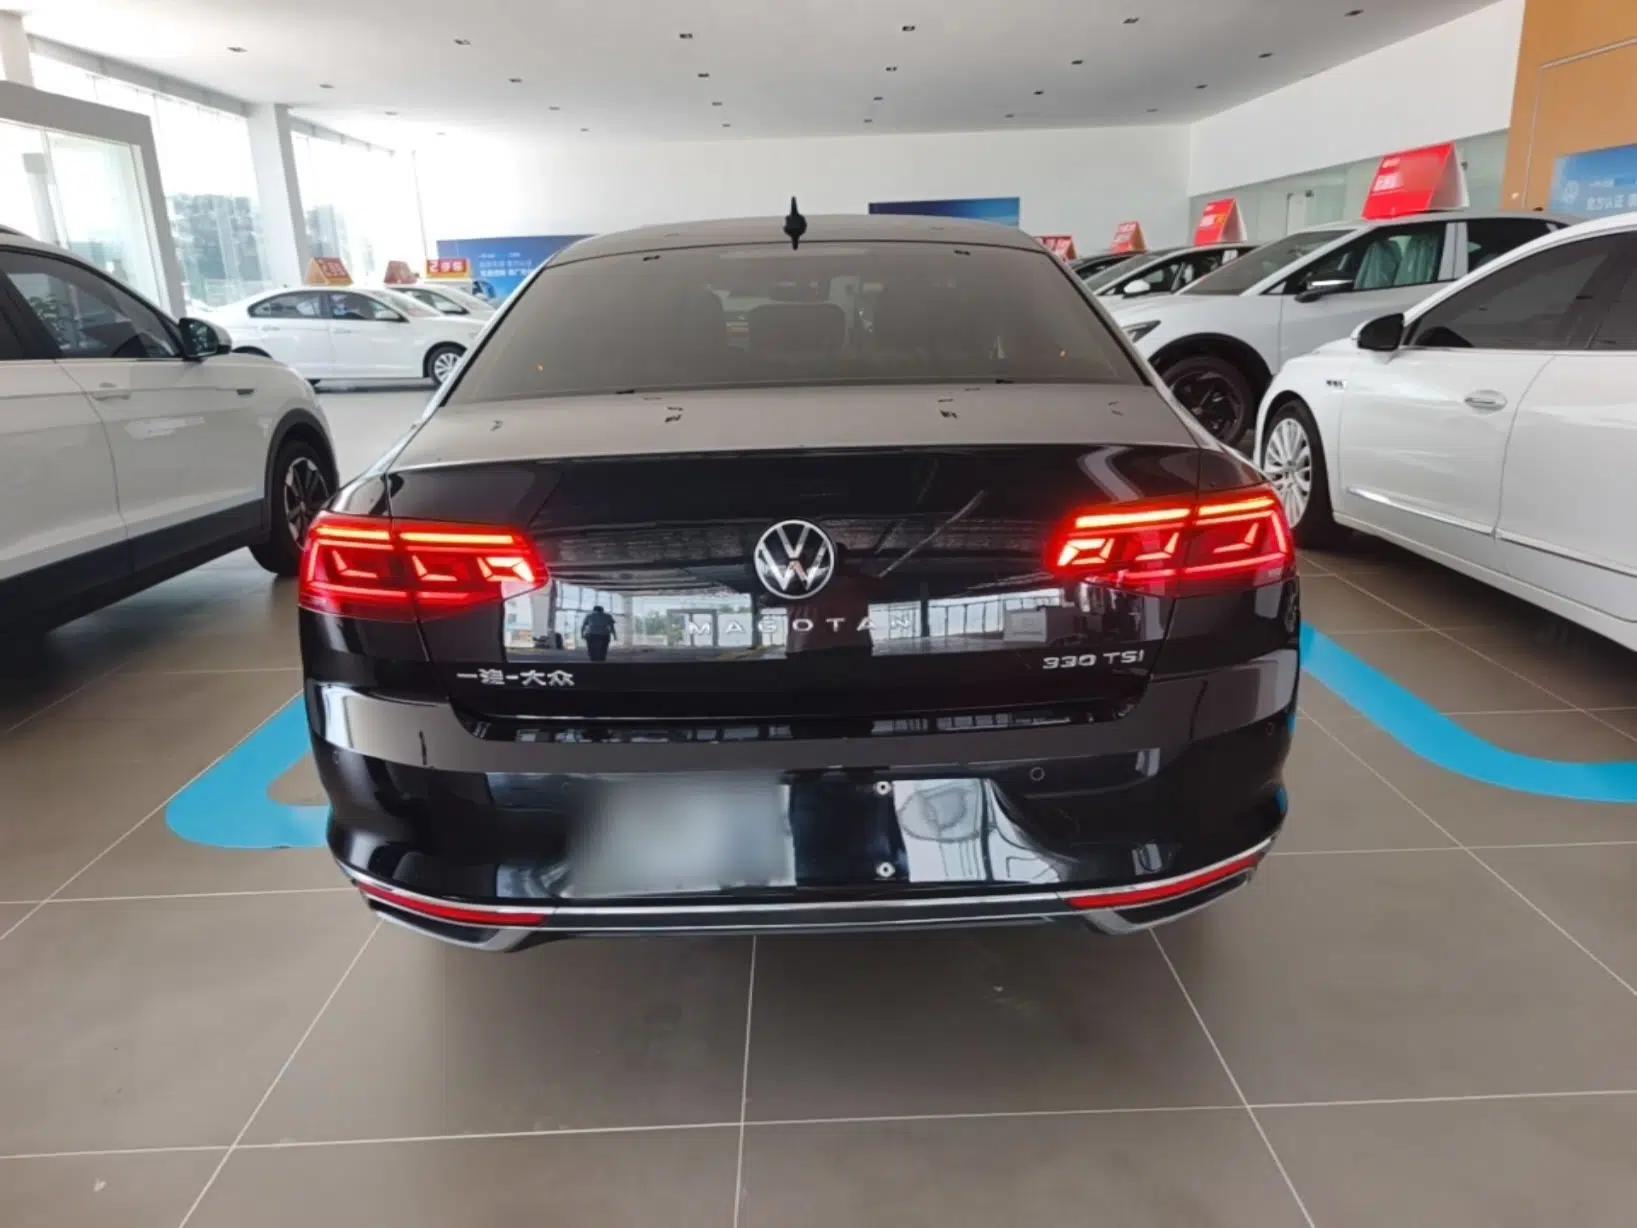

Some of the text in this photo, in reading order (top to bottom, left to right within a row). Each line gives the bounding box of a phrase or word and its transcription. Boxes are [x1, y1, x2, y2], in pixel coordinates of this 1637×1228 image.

[688, 615, 913, 637] MAGOTAN
[1042, 649, 1145, 670] 330 TSI
